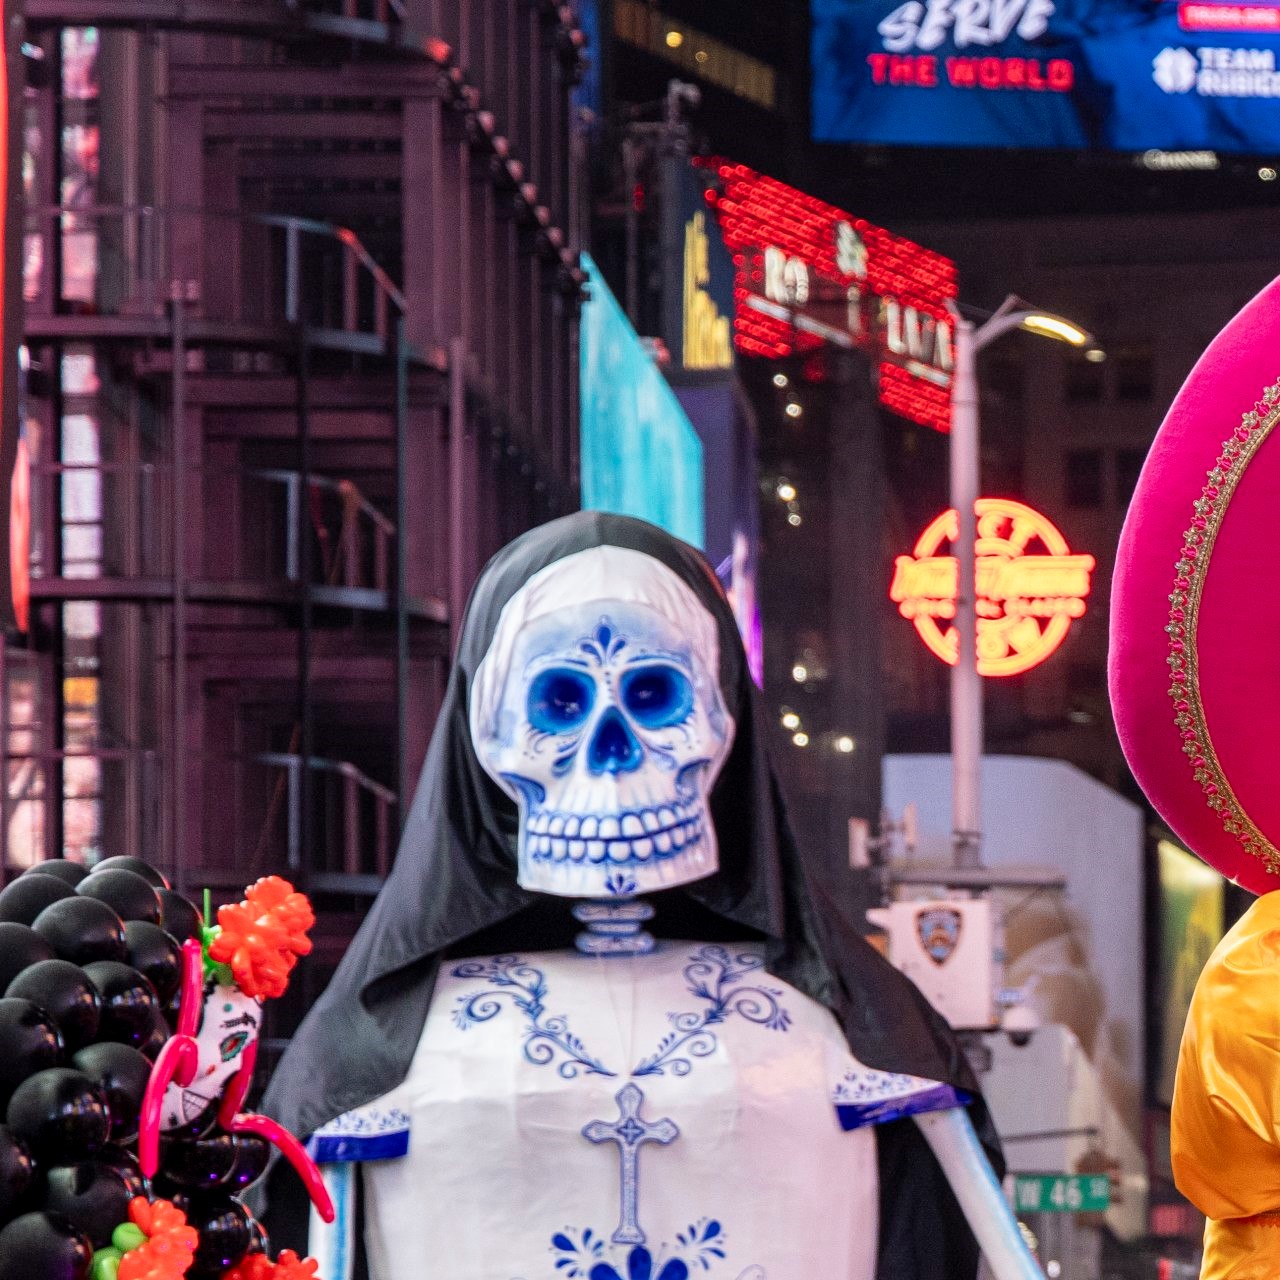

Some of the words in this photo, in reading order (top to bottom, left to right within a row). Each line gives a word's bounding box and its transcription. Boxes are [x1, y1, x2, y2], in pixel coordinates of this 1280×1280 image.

[867, 53, 938, 87] THE
[945, 55, 1074, 92] WORLD
[1197, 47, 1276, 71] TEAM
[1020, 1181, 1041, 1206] W
[1049, 1179, 1083, 1207] 46
